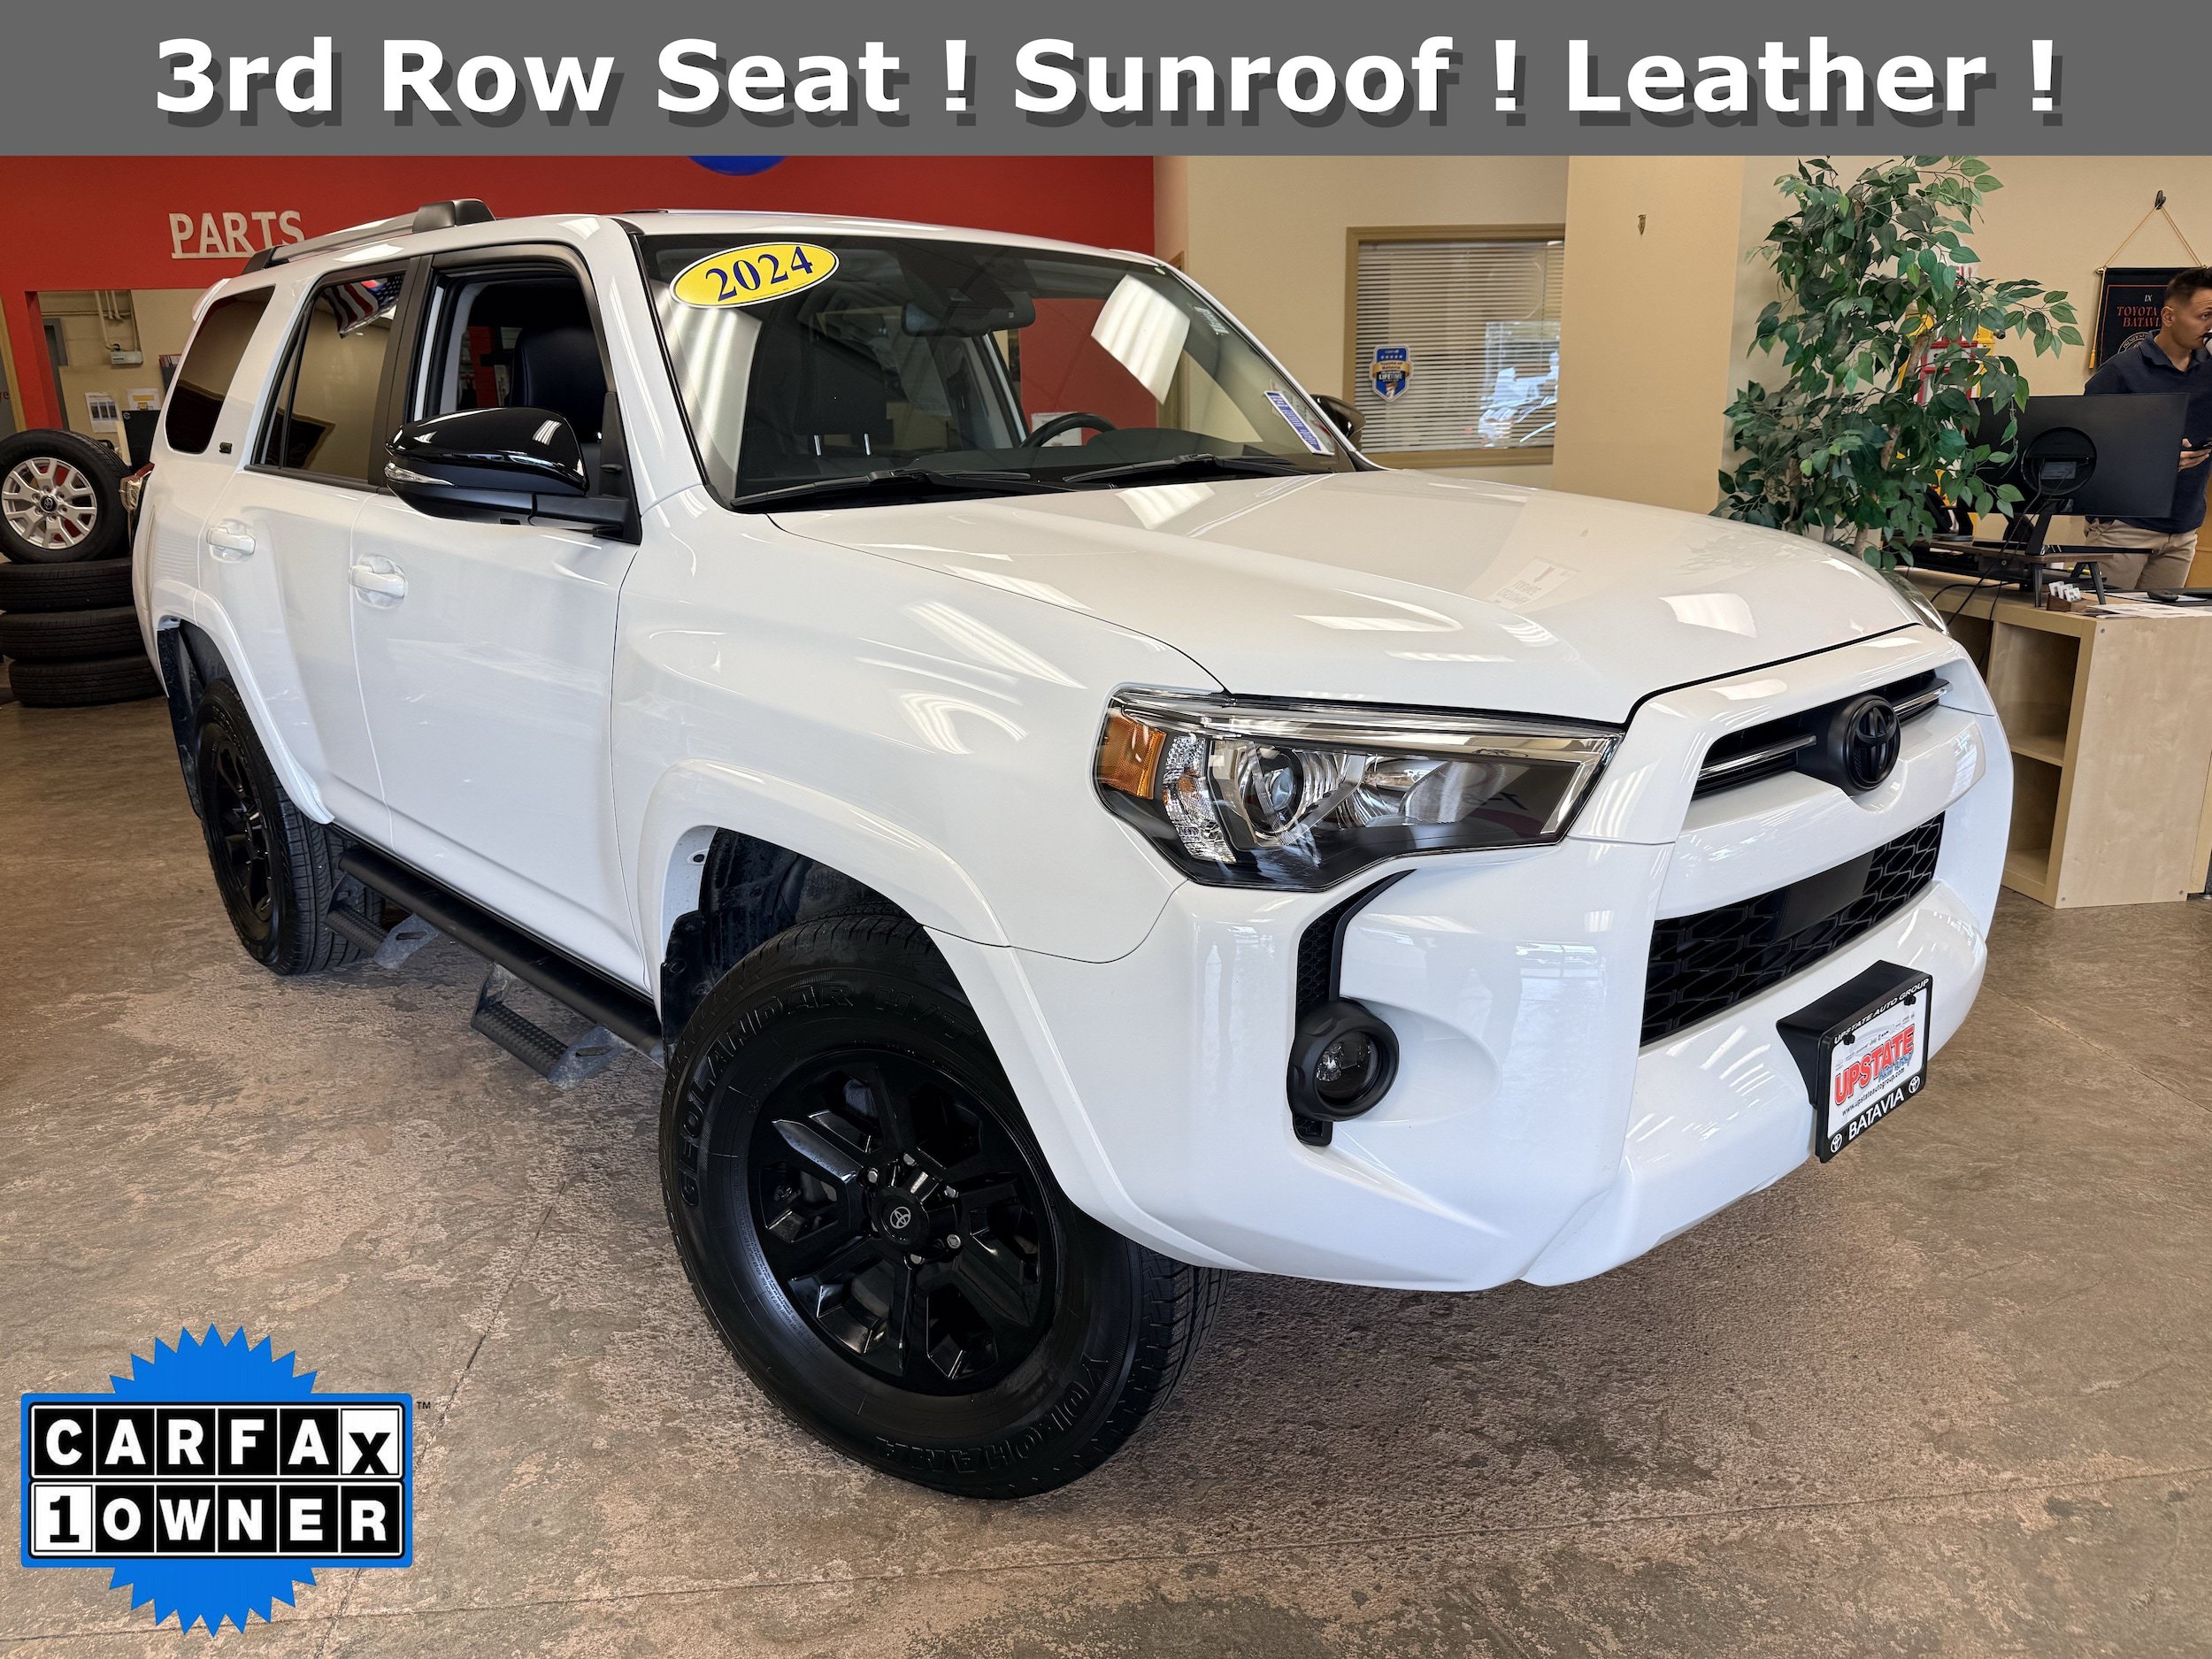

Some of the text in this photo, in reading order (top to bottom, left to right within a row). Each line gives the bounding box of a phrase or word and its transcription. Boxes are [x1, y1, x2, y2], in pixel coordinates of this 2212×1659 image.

[168, 210, 305, 259] PARTS
[705, 246, 813, 302] 2024
[2116, 306, 2158, 317] TOYOTA
[2123, 317, 2162, 327] BATAVI
[1834, 1012, 1873, 1045] UPSTATE
[1872, 997, 1898, 1018] AUTO
[1899, 978, 1929, 1001] GROUP
[1834, 1023, 1915, 1106] UPSTATE
[1842, 1067, 1905, 1117] www.upstateautogroup.com
[678, 980, 855, 1208] GEOLANDAR
[1847, 1087, 1905, 1141] BATAVIA
[876, 1353, 1109, 1473] YOKOHAMA
